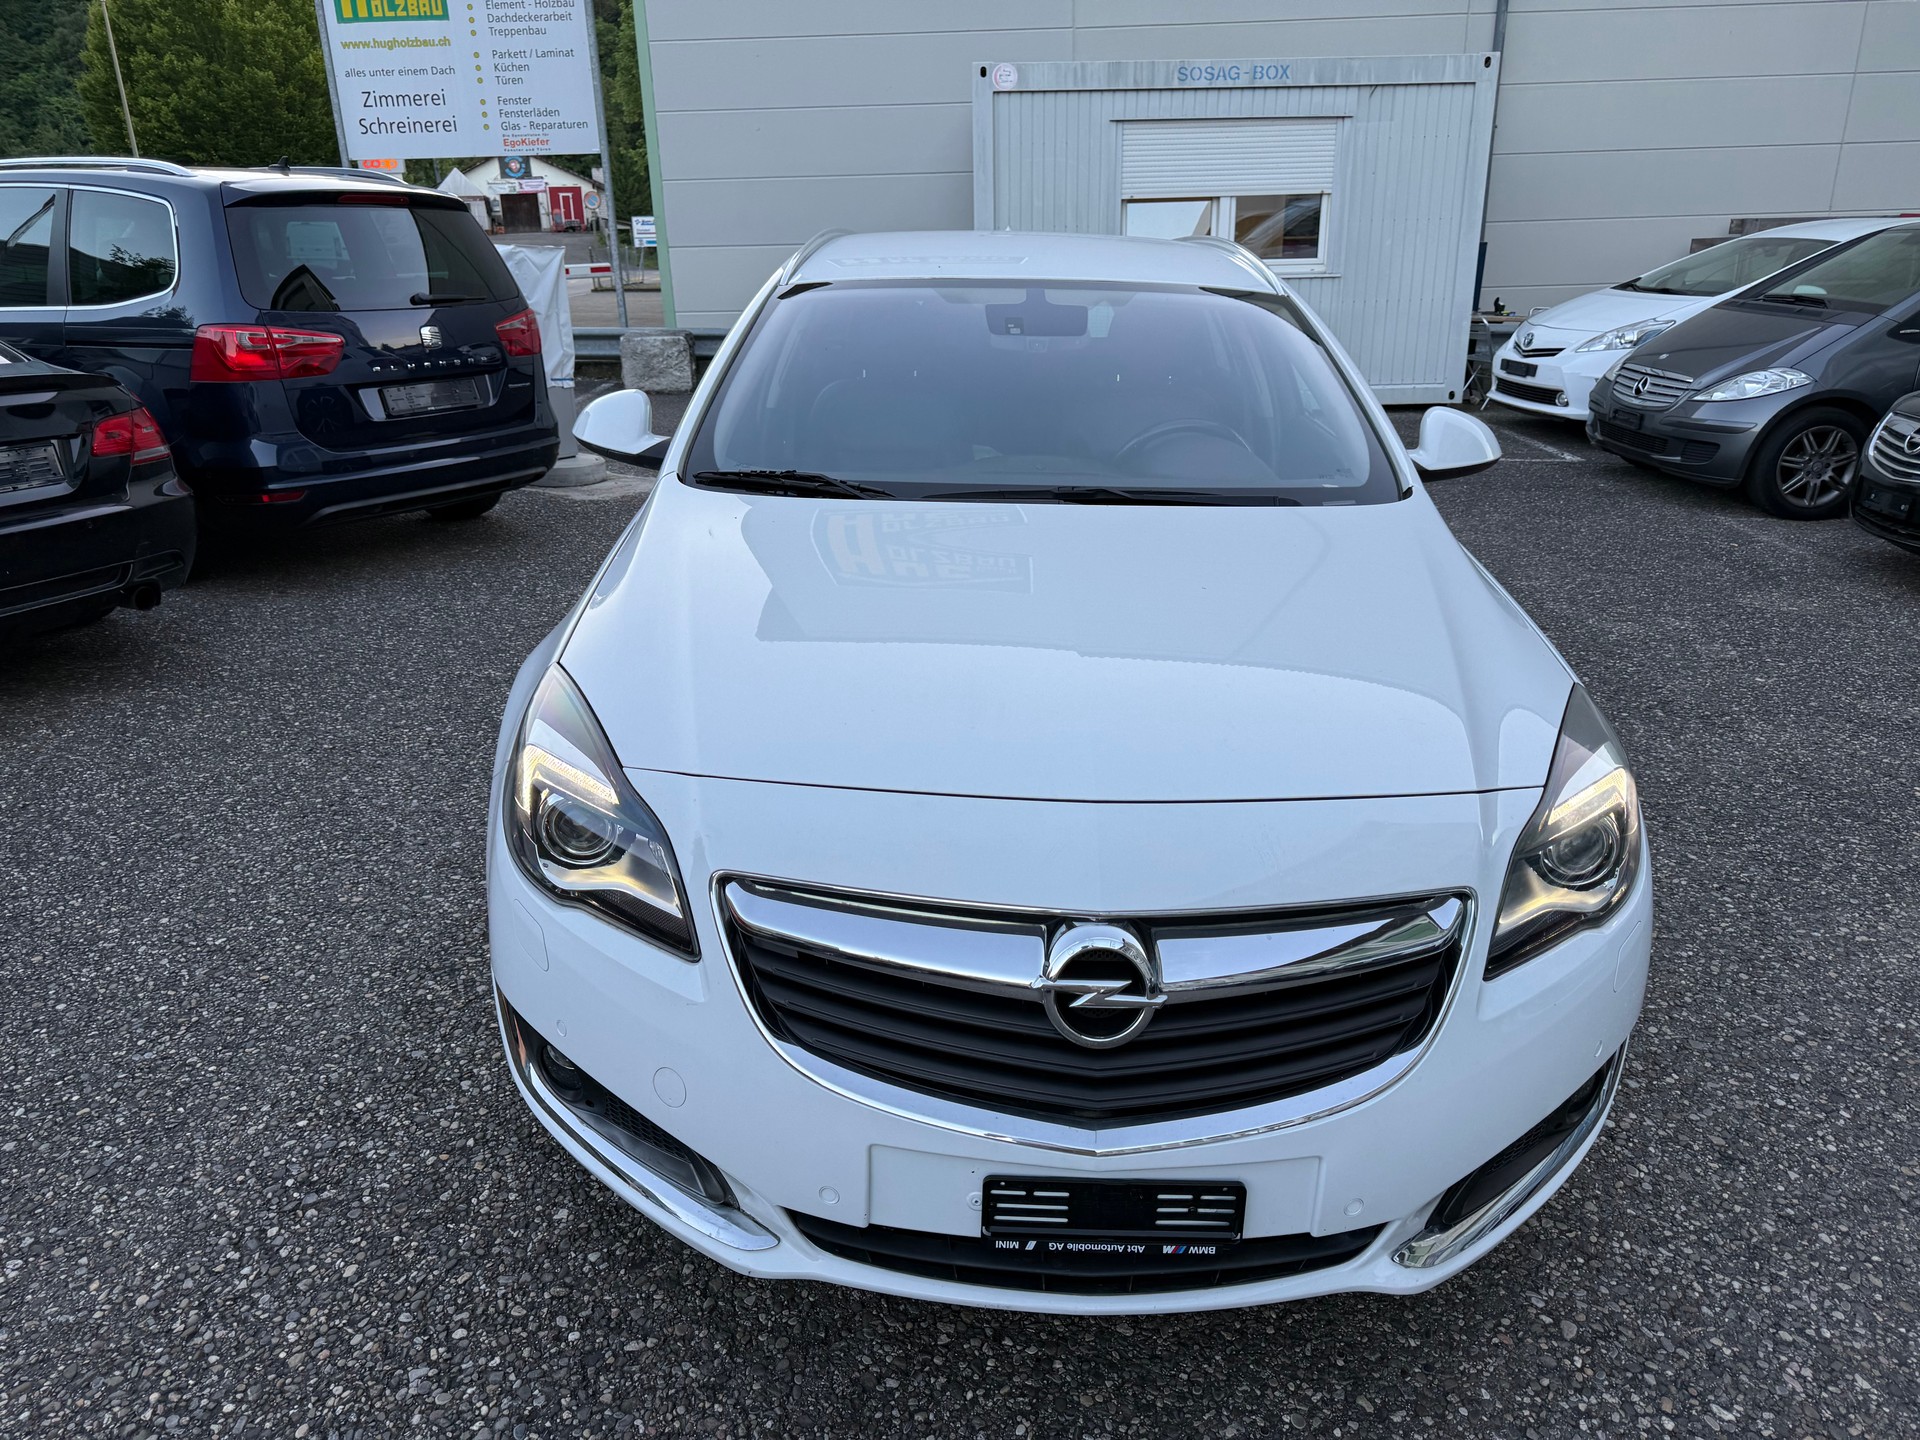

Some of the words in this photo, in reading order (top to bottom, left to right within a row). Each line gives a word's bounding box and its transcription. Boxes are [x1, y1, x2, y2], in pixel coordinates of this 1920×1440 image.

[485, 0, 526, 10] Element
[535, 0, 575, 9] Holzbau
[487, 11, 573, 23] Dachdeckerarbeit
[488, 25, 547, 38] Treppenbau
[341, 36, 451, 51] www.hugholzbau.ch
[492, 49, 527, 60] Parkett
[535, 48, 575, 59] Laminat
[344, 68, 367, 78] alles
[368, 68, 395, 77] unter
[398, 66, 428, 76] einem
[431, 65, 456, 75] Dach
[493, 62, 530, 72] Küchen
[495, 75, 524, 85] Türen
[361, 88, 446, 108] Zimmerei
[497, 96, 532, 105] Fenster
[499, 107, 560, 118] Fensterläden
[358, 115, 458, 135] Schreinerei
[501, 120, 521, 131] Glas
[529, 120, 588, 132] Reparaturen
[503, 137, 550, 148] EgoKiefer
[995, 1240, 1019, 1249] MINI
[1048, 1242, 1064, 1251] AG
[1066, 1243, 1125, 1252] Automobile
[1127, 1244, 1145, 1253] Abt
[1188, 1246, 1216, 1254] BMW
